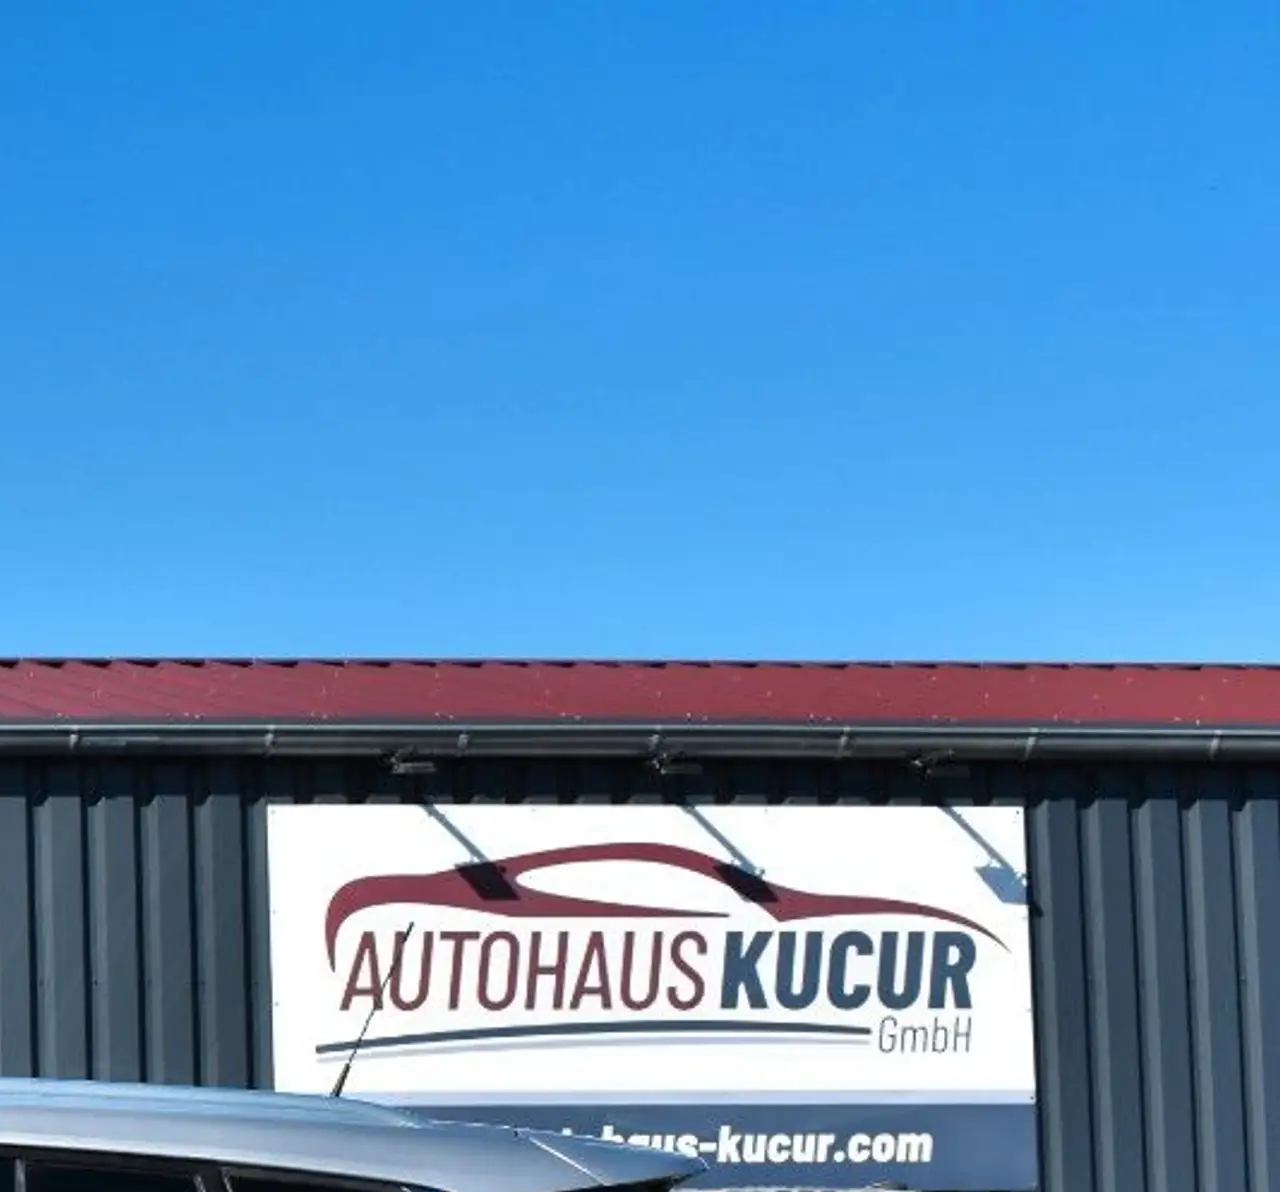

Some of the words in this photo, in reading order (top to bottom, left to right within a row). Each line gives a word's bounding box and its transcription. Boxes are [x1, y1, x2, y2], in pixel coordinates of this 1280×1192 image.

[340, 930, 708, 1012] AUTOHAUS
[720, 930, 977, 1011] KUCUR
[878, 1015, 972, 1054] GmbH
